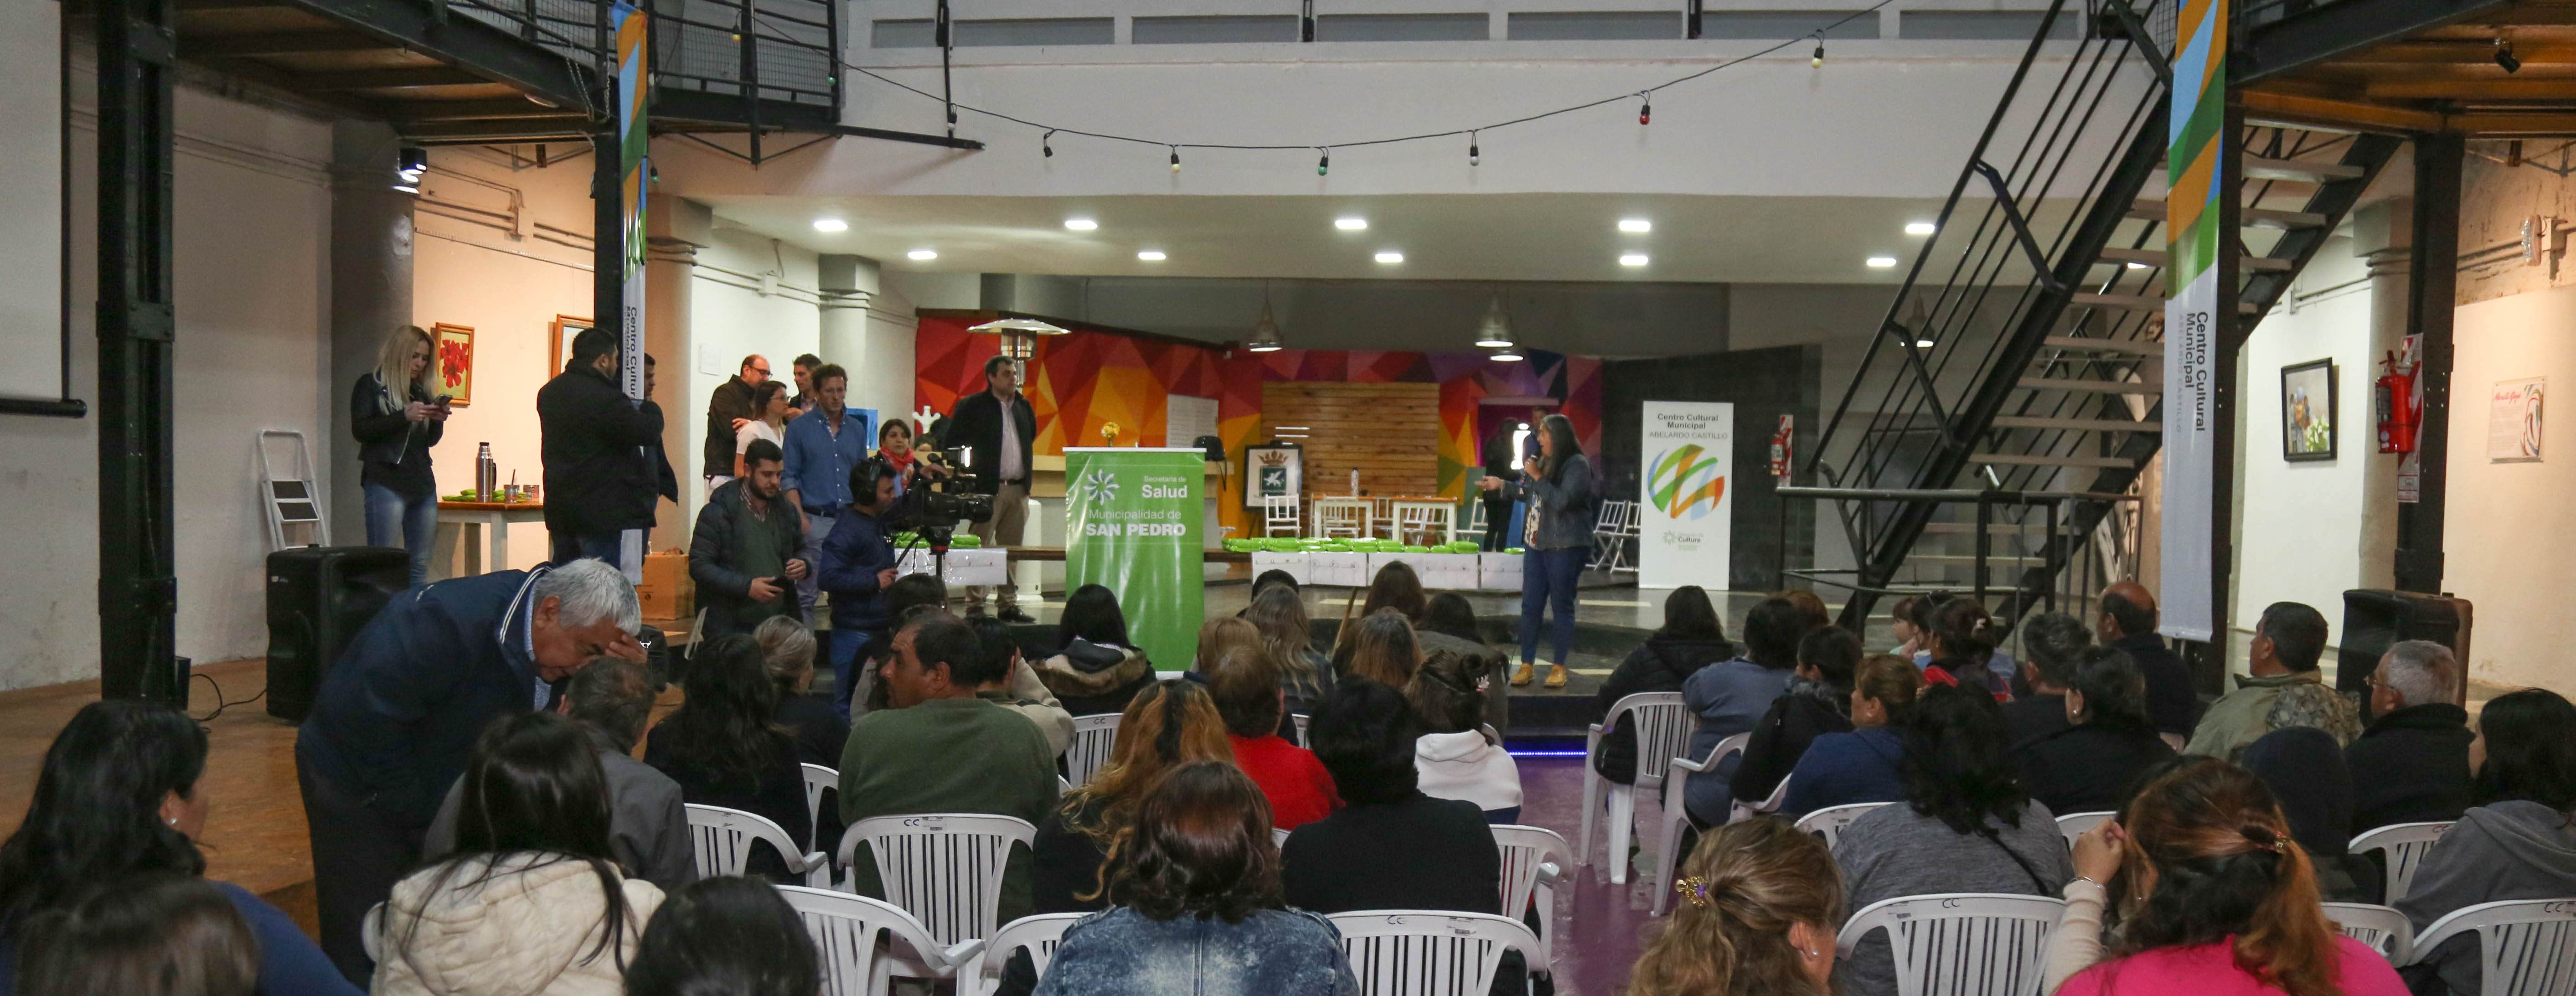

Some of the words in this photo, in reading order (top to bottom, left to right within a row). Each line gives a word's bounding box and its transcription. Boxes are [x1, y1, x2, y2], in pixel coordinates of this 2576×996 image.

[2197, 311, 2208, 365] Centro
[2184, 313, 2195, 387] Municipal
[2196, 370, 2207, 431] Cultural
[1667, 422, 1706, 430] Municipal
[1142, 484, 1188, 498] Salud
[1089, 509, 1164, 521] Municipalidad
[1168, 510, 1182, 519] de
[1086, 524, 1121, 536] SAN
[1127, 524, 1186, 536] PEDRO
[1942, 898, 1960, 908] CC
[1388, 914, 1405, 924] CC
